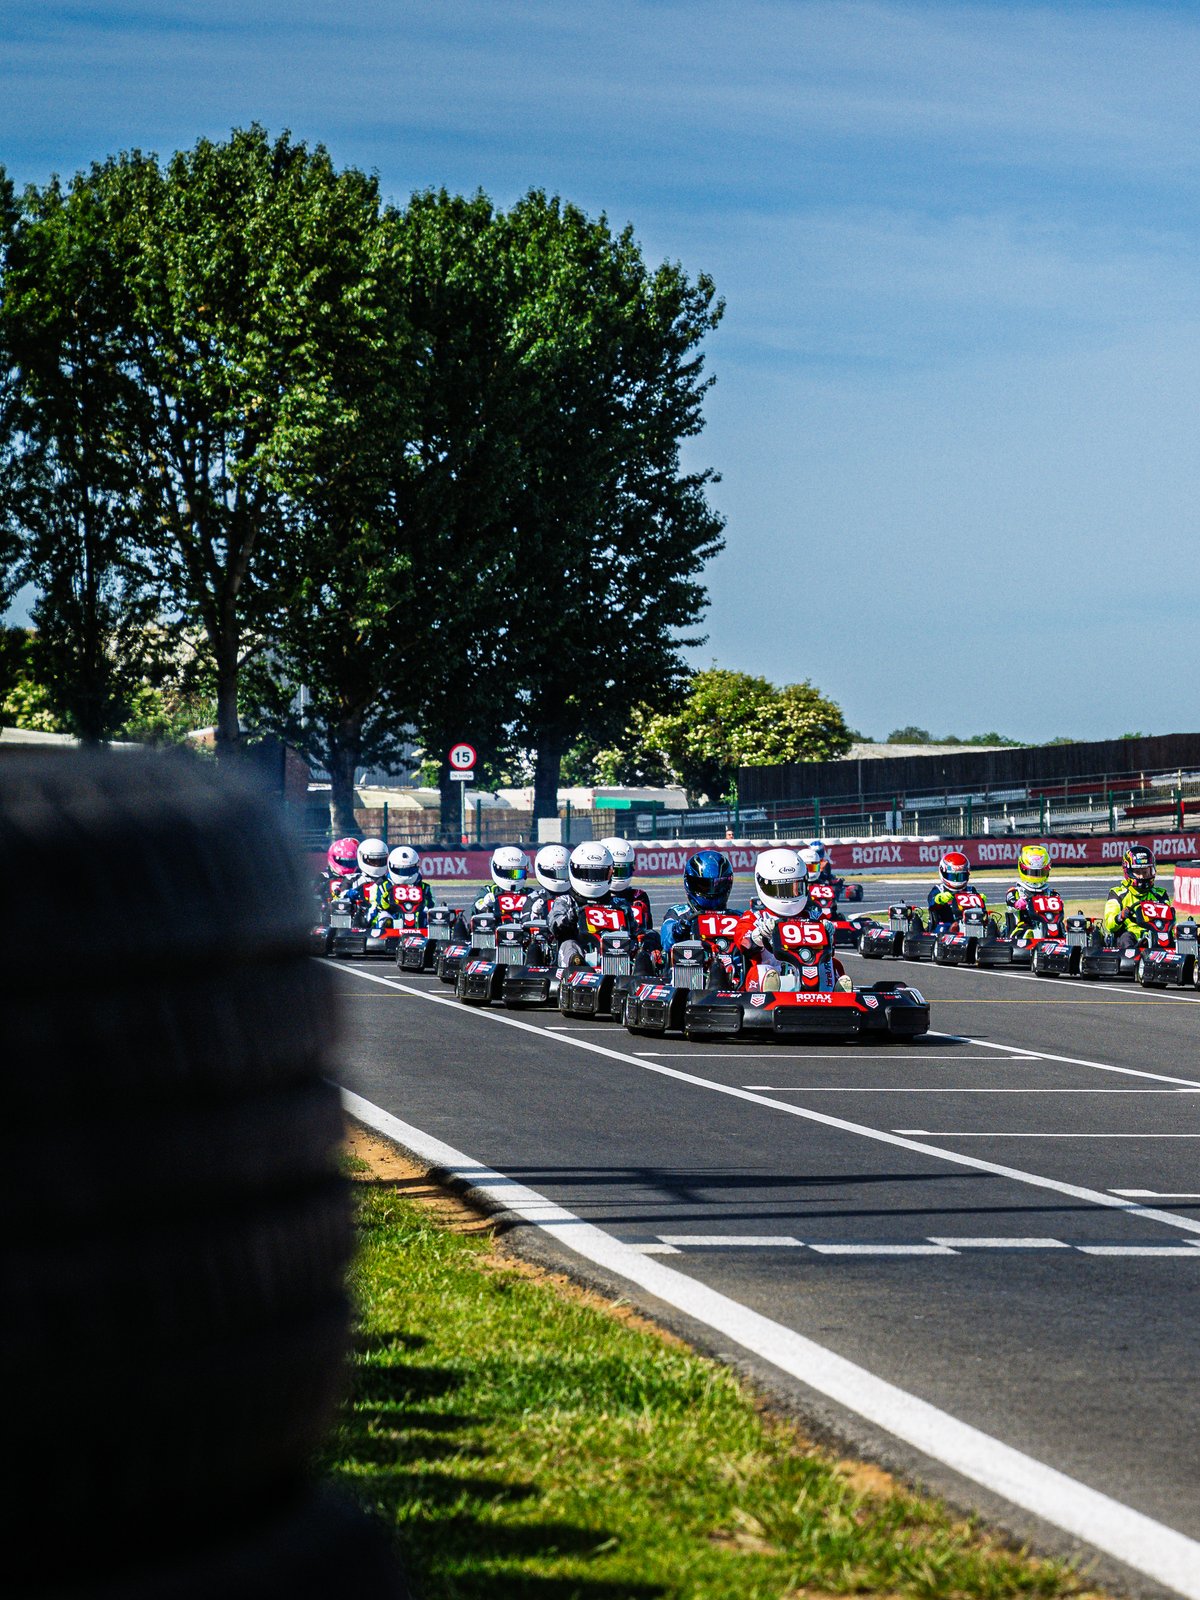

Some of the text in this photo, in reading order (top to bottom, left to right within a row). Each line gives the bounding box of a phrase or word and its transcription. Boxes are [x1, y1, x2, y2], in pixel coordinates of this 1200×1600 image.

[455, 751, 470, 763] 15
[978, 844, 1021, 860] ROTAX
[1153, 838, 1197, 854] ROTAX
[637, 853, 687, 870] ROTAX
[852, 846, 901, 863] ROTAX
[421, 857, 468, 875] OTAX
[395, 887, 420, 901] 88
[811, 887, 833, 898] 43
[957, 895, 982, 907] 20
[1035, 898, 1060, 911] 16
[589, 909, 620, 930] 31
[1143, 904, 1169, 919] 37
[702, 917, 738, 935] 12
[782, 924, 824, 945] 95
